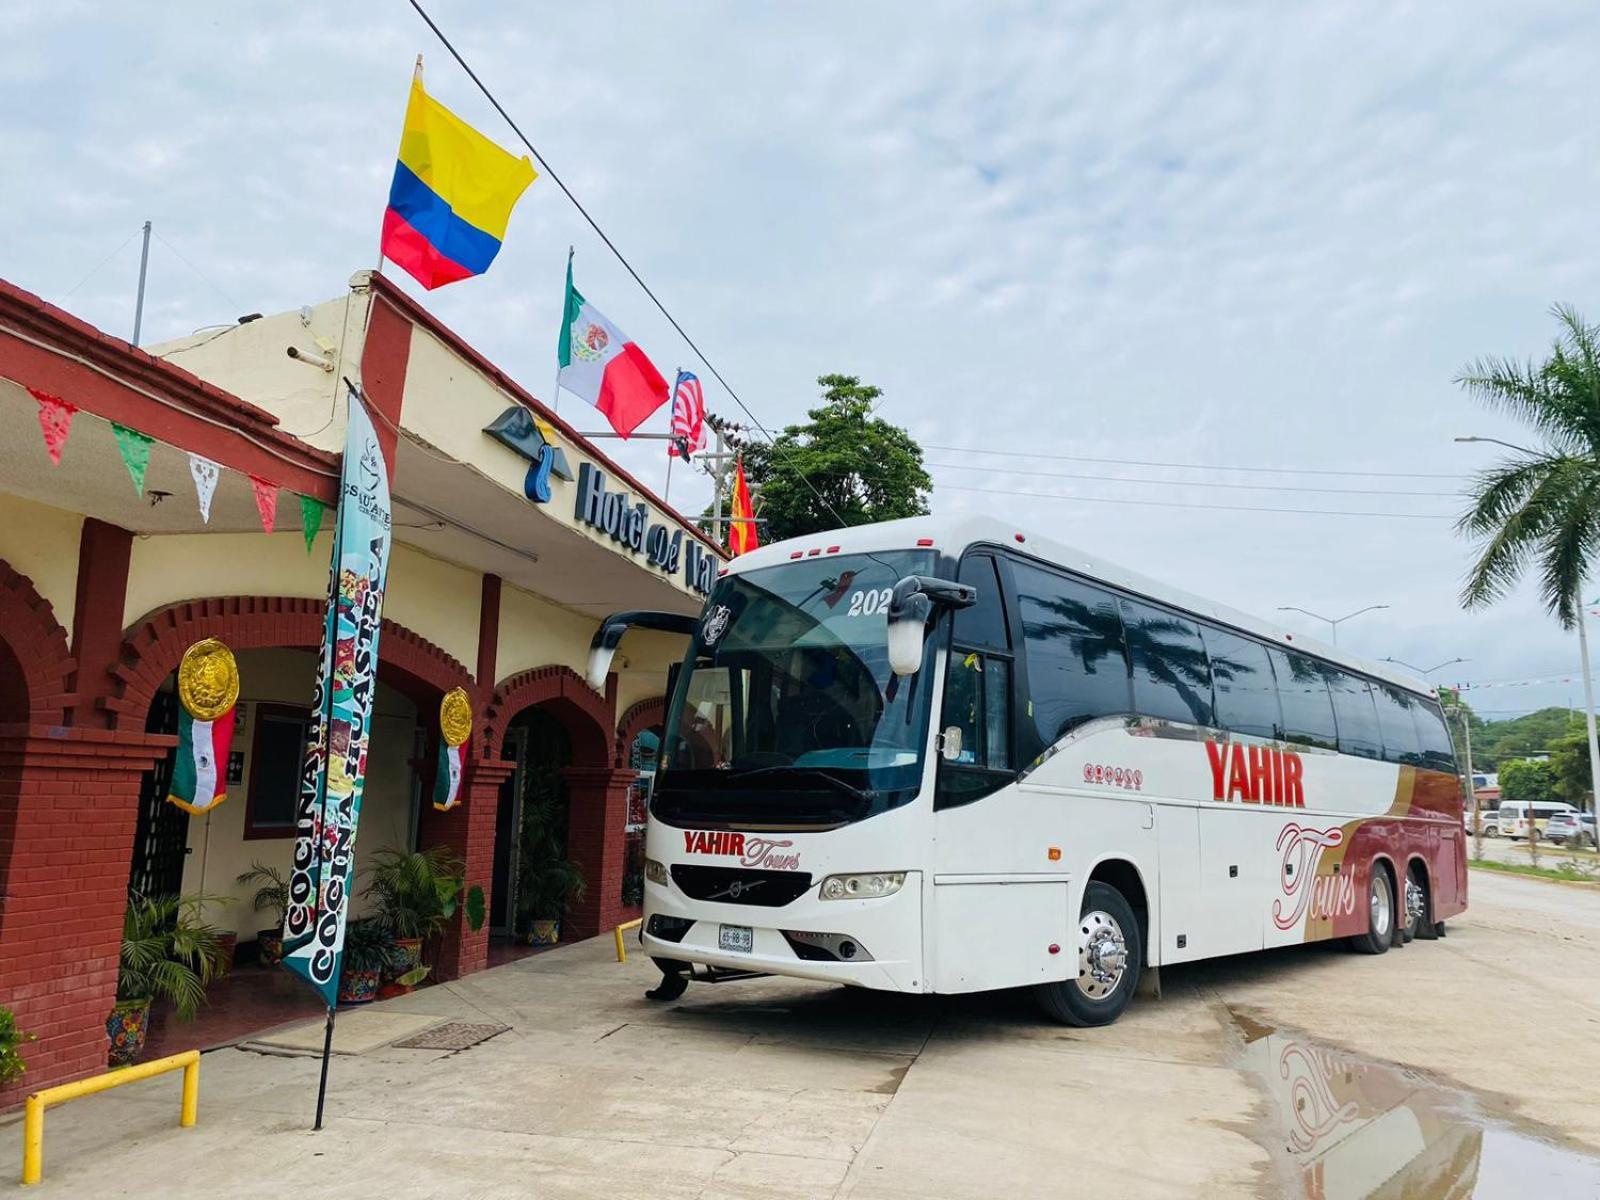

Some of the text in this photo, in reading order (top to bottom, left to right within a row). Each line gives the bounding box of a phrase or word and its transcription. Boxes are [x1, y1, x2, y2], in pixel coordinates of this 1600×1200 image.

[575, 463, 648, 555] Hotel
[308, 790, 355, 984] COCINA
[344, 536, 384, 781] HUASTECA
[1205, 737, 1305, 809] YAHIR
[287, 752, 321, 936] COCINA
[683, 831, 801, 870] YAHIR Tours
[1272, 822, 1356, 931] Tours
